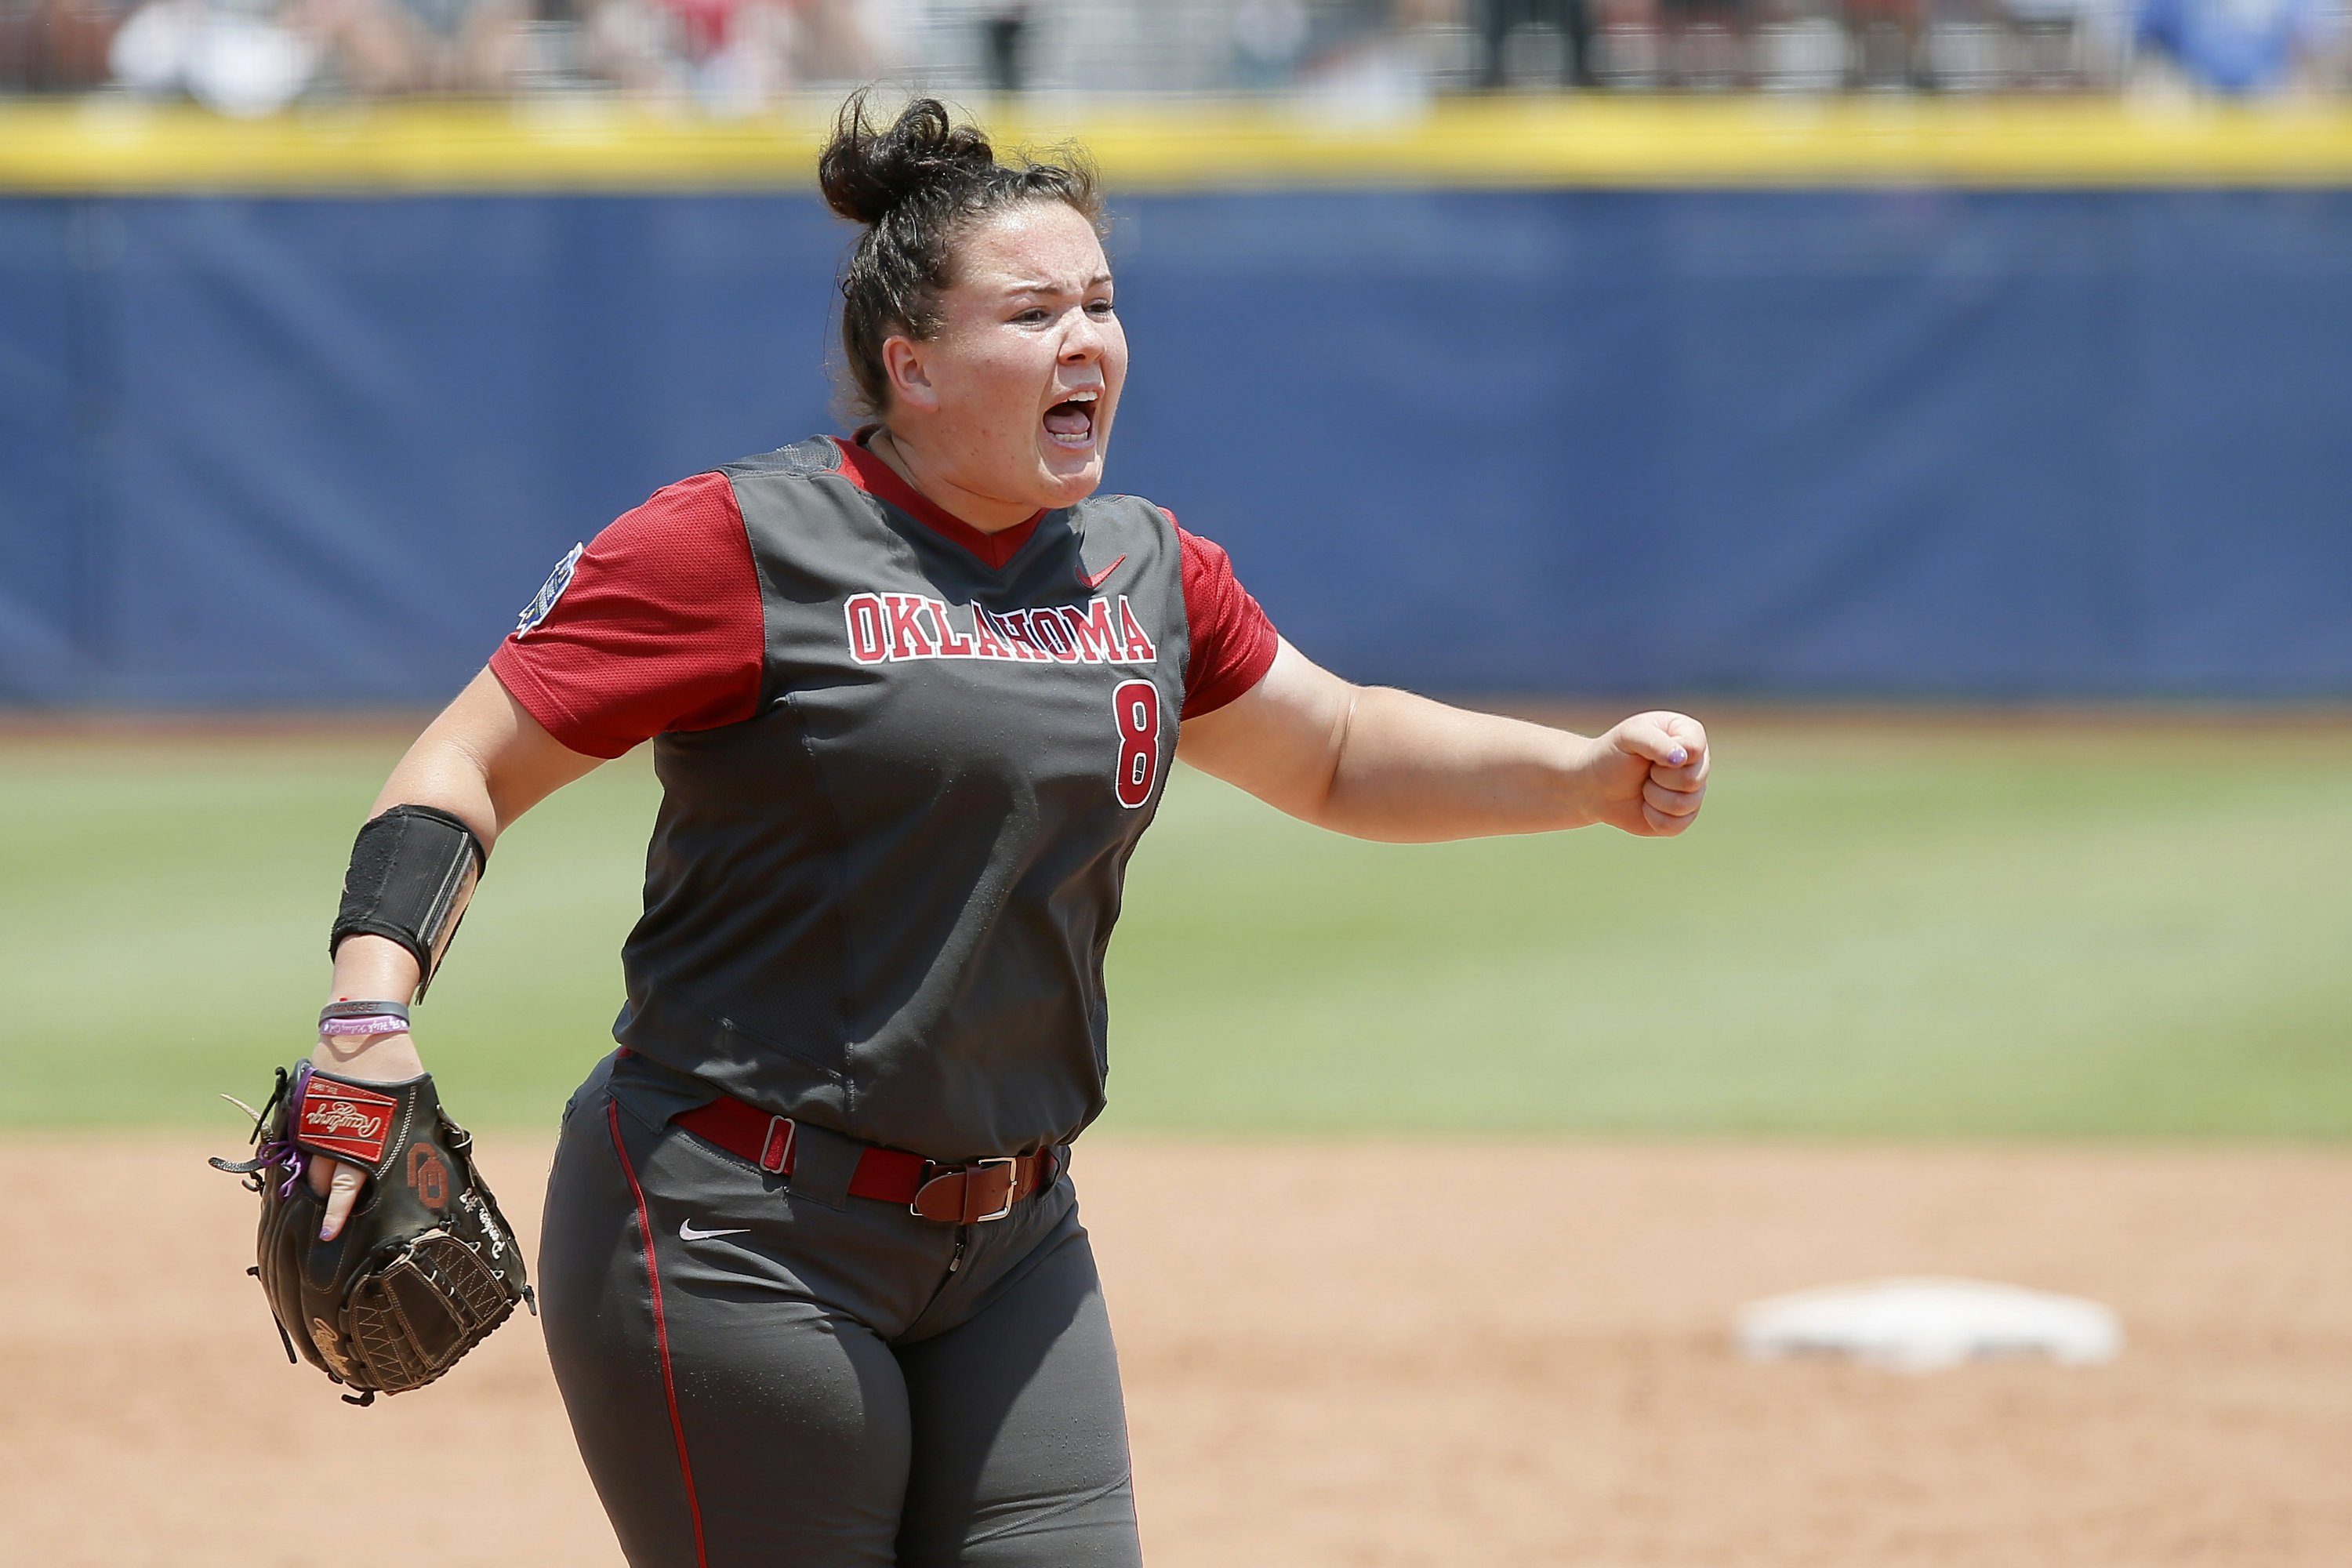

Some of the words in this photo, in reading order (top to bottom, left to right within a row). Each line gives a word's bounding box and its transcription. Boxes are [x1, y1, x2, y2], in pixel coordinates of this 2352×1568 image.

[844, 592, 1157, 665] OKLAHOMA
[1112, 679, 1160, 809] 8
[332, 1003, 382, 1014] MINDSET
[367, 1020, 389, 1033] High
[306, 1102, 382, 1138] Rawlings
[407, 1142, 448, 1209] OU
[459, 1187, 478, 1214] #8
